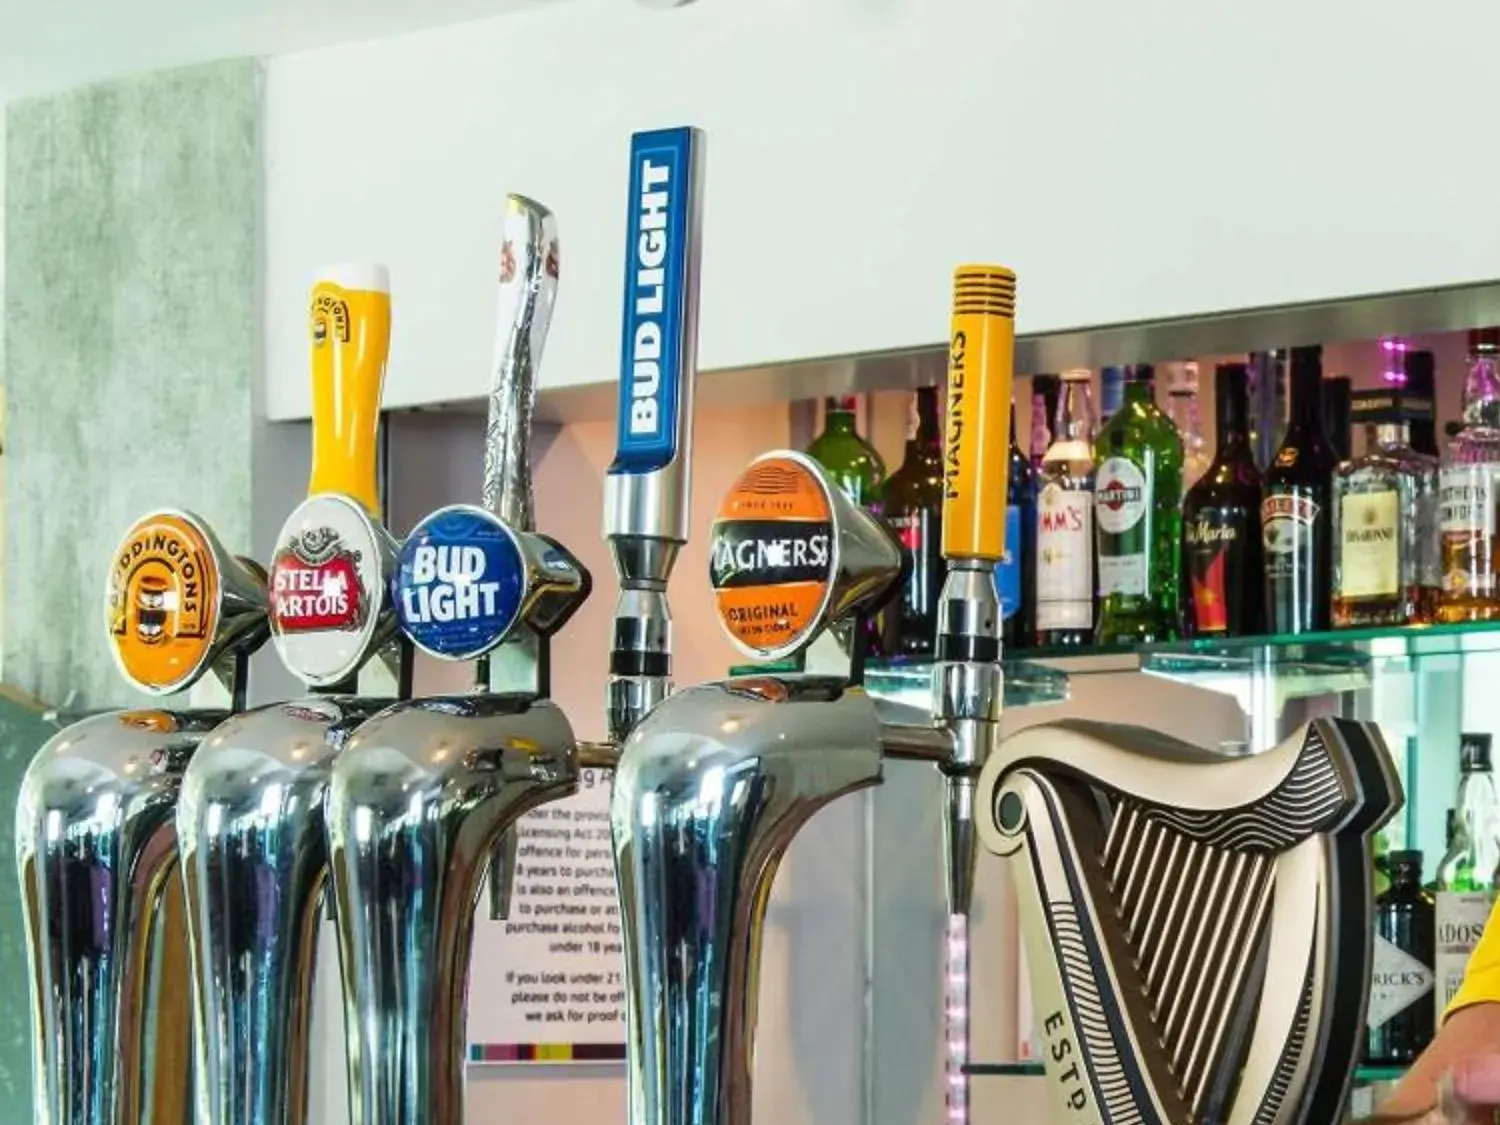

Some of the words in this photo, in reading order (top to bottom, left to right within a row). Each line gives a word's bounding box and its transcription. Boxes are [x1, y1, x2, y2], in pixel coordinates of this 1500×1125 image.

[635, 160, 669, 315] LIGHT
[630, 321, 661, 434] BUD
[946, 330, 966, 499] MAGNERS
[1098, 488, 1141, 501] MARTINI
[1039, 505, 1082, 533] MM'S
[711, 535, 821, 572] MAGNERS
[413, 545, 486, 583] BUD
[274, 568, 349, 592] STELLA
[276, 593, 349, 617] ARTOIS
[402, 582, 500, 624] LIGHT
[729, 601, 798, 622] ORIGINAL
[552, 808, 571, 819] the
[574, 829, 592, 839] Act
[519, 844, 563, 857] offence
[566, 846, 583, 857] for
[586, 848, 612, 861] pers
[528, 867, 557, 878] years
[560, 866, 573, 876] to
[530, 885, 553, 895] also
[557, 886, 570, 895] an
[520, 904, 531, 915] to
[534, 904, 587, 916] purchase
[590, 906, 601, 915] or
[506, 922, 559, 935] purchase
[562, 921, 604, 934] alcohol
[549, 942, 583, 953] under
[587, 942, 600, 952] 18
[506, 971, 515, 983] If
[517, 975, 538, 986] you
[541, 971, 566, 983] look
[570, 973, 603, 983] under
[511, 991, 550, 1006] please
[553, 992, 567, 1002] do
[570, 993, 589, 1002] not
[593, 992, 607, 1003] be
[525, 1012, 541, 1021] we
[546, 1009, 565, 1021] ask
[568, 1008, 583, 1021] for
[587, 1009, 618, 1024] proof
